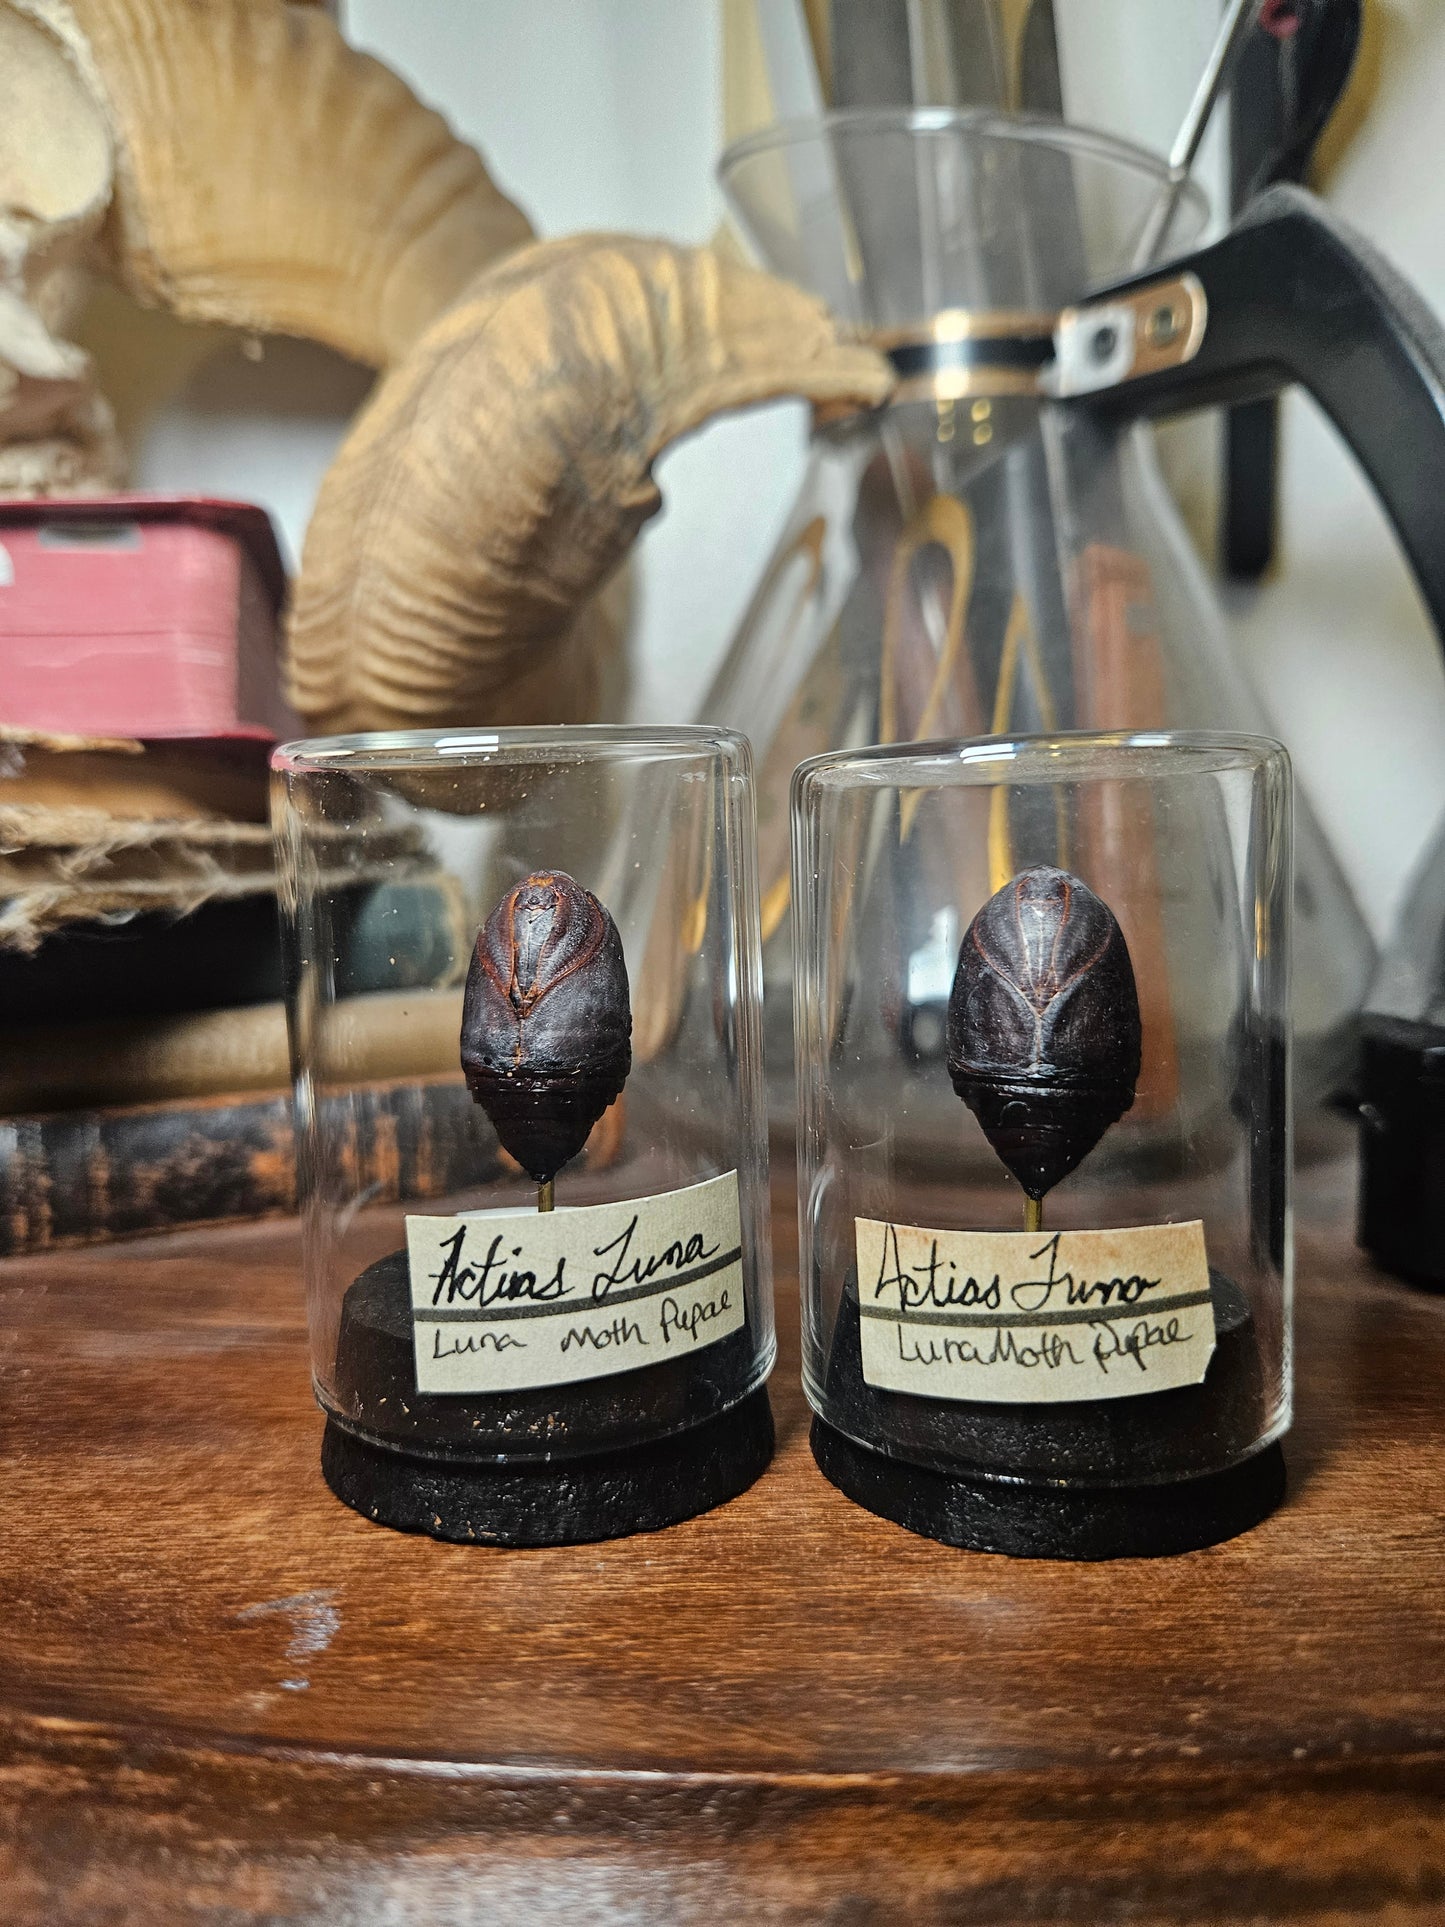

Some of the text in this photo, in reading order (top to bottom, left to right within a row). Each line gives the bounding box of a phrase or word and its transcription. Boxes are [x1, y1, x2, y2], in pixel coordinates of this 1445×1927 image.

[592, 1214, 721, 1302] Luna
[432, 1328, 528, 1360] Luna
[561, 1316, 650, 1352] Moth
[897, 1323, 991, 1367] Luna
[987, 1326, 1084, 1368] Moth
